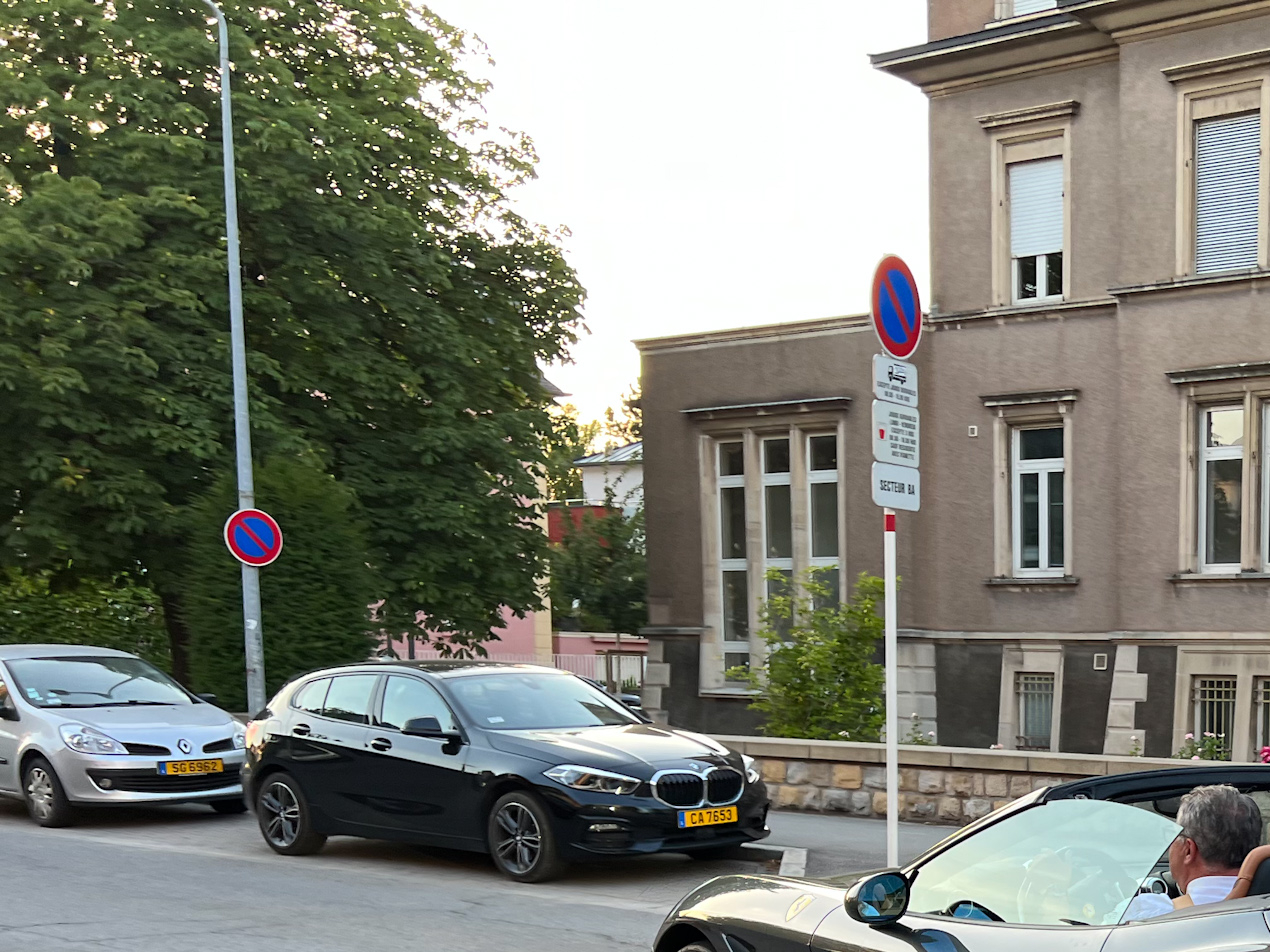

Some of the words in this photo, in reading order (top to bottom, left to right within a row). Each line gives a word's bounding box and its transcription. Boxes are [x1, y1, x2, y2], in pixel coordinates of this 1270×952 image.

[879, 479, 905, 494] SECTEUR
[908, 484, 915, 495] BA
[172, 763, 187, 773] SG
[690, 812, 704, 825] CA
[706, 809, 732, 822] 7653
